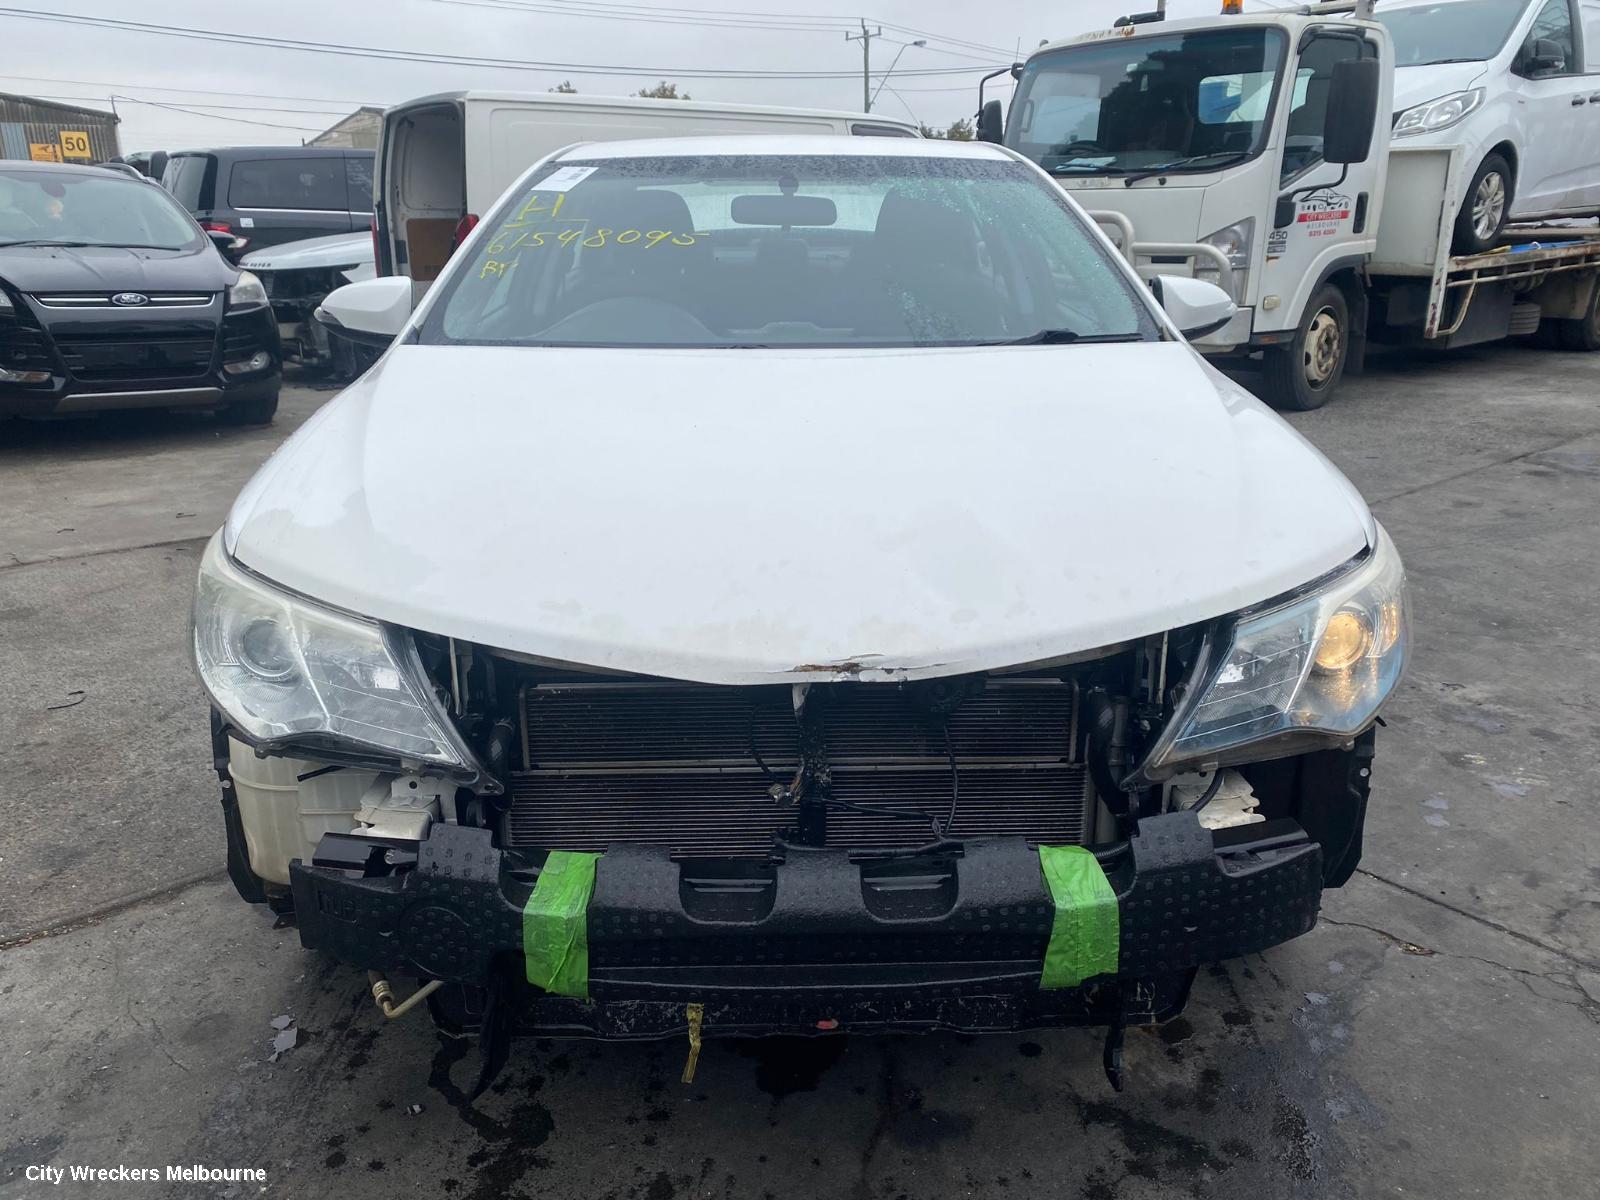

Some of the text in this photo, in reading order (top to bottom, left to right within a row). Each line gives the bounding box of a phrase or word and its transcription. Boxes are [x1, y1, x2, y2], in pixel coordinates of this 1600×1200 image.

[65, 136, 87, 151] 50
[1269, 230, 1288, 240] 450
[120, 293, 141, 304] Ford
